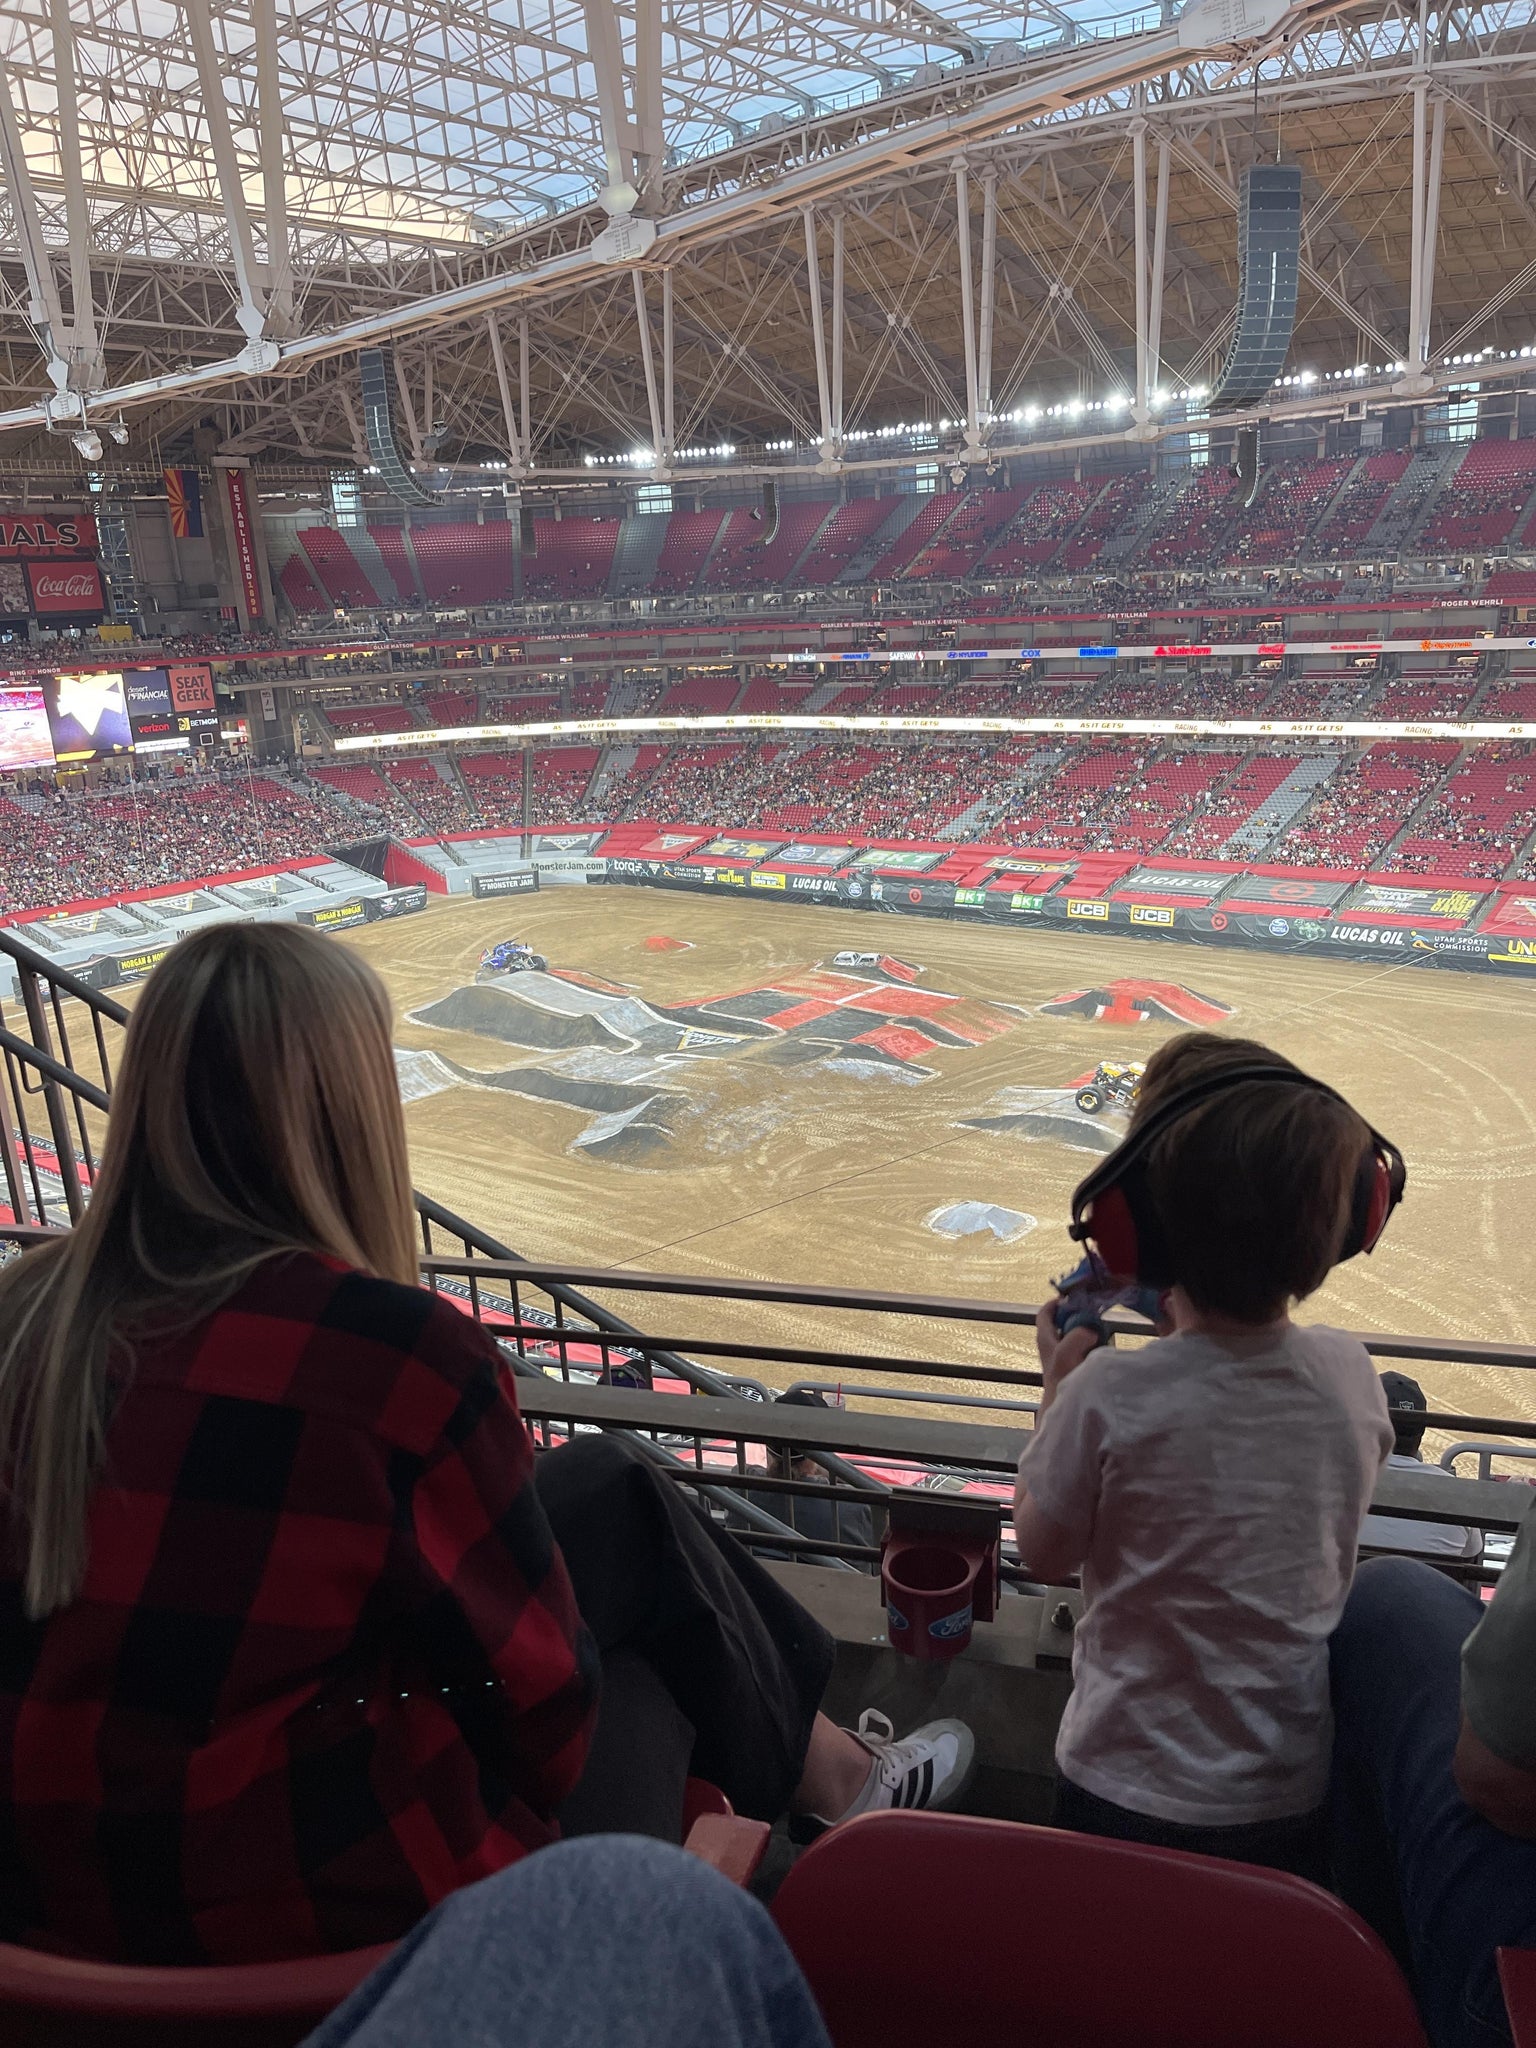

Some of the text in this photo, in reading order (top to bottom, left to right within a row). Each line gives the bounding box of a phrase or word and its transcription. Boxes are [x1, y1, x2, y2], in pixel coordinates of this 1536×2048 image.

[233, 484, 252, 580] ESTABLISHED
[36, 574, 95, 598] Coca-Cola
[1470, 598, 1503, 606] WEHRLI
[889, 652, 916, 660] SAFEWAY
[1021, 649, 1041, 657] COX
[176, 675, 205, 689] SEAT
[177, 688, 209, 702] GEEK
[190, 717, 218, 727] BETMGM
[1174, 723, 1198, 732] RACING
[138, 723, 170, 734] verizon
[1404, 725, 1433, 735] RACING
[531, 862, 604, 871] MonsterJam.com
[487, 881, 518, 890] MONSTER
[519, 879, 534, 887] JAM
[792, 878, 821, 890] LUCAS
[1129, 875, 1225, 888] LUCAS OIL
[956, 890, 986, 902] BKT
[1012, 895, 1043, 907] BKT
[316, 910, 337, 922] MORGAN
[342, 904, 362, 917] MORGAN
[1071, 903, 1105, 916] JCB
[1133, 909, 1170, 922] JCB
[1331, 926, 1376, 943] LUCAS
[1458, 937, 1488, 946] SPORTS
[1433, 943, 1488, 953] COMMISSION
[121, 957, 146, 970] MORGAN
[152, 951, 168, 962] MOR
